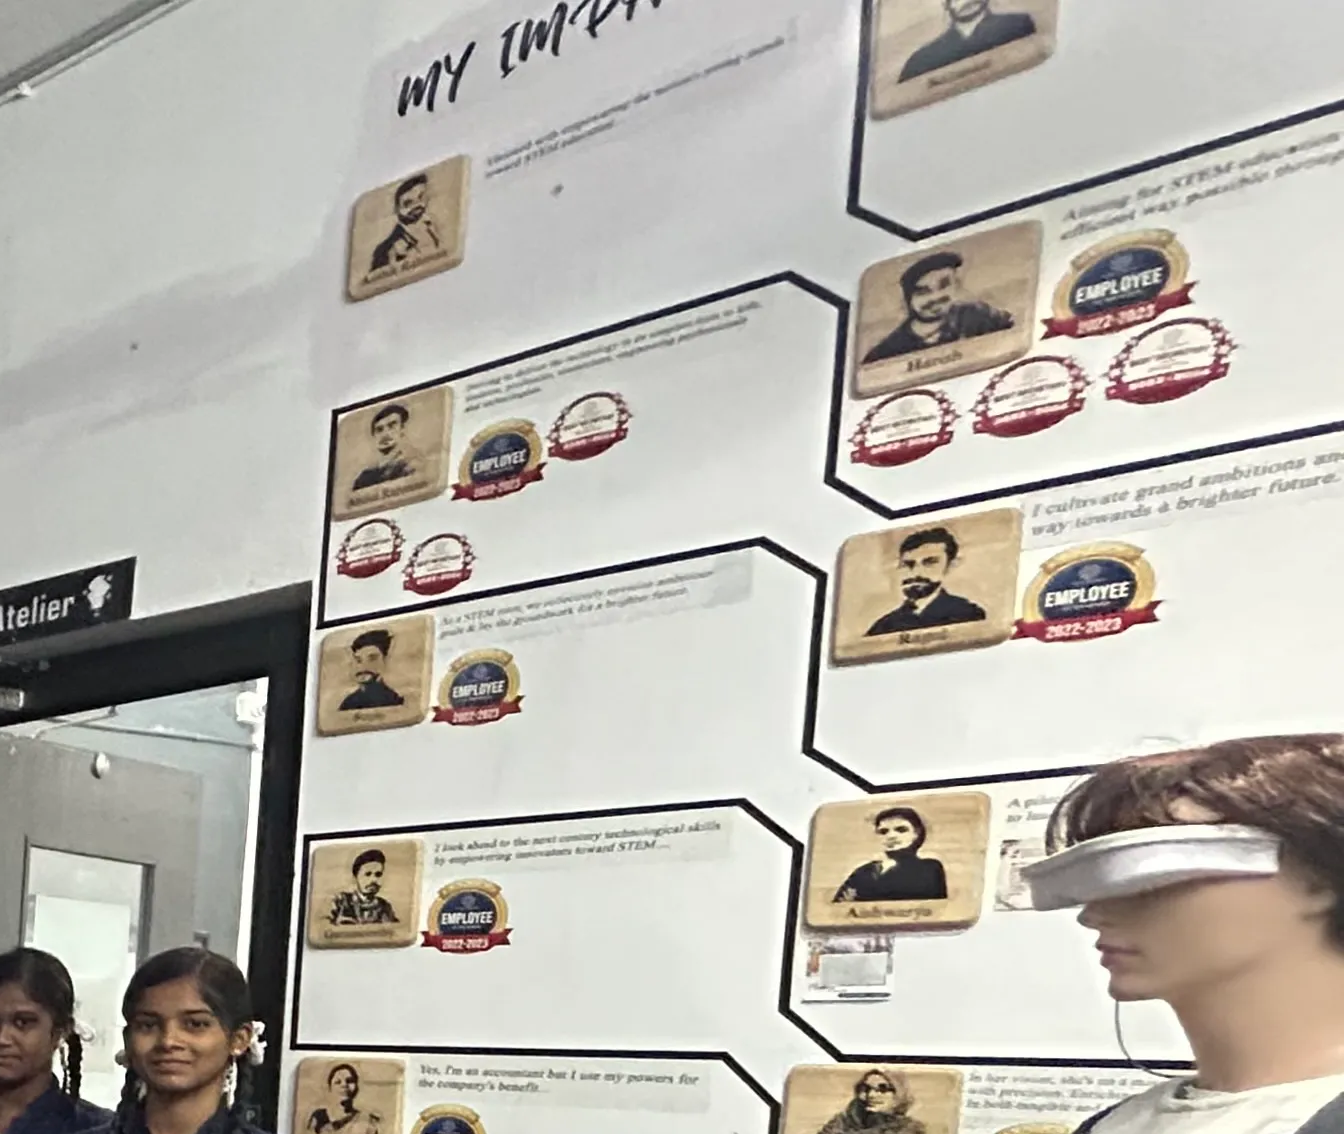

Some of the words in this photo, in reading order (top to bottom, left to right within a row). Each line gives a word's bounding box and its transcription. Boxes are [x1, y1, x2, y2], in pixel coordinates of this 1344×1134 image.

[398, 41, 476, 116] MY
[1075, 265, 1164, 305] EMPLOYEE
[473, 448, 527, 474] EMPLOYEE
[1032, 502, 1042, 519] I
[1045, 488, 1130, 517] cultivate
[1134, 476, 1195, 503] grand
[1199, 456, 1307, 488] ambitions
[1031, 520, 1069, 538] way
[1076, 503, 1153, 530] towards
[1158, 502, 1171, 515] a
[1176, 486, 1262, 513] brighter
[1268, 471, 1342, 496] future.
[1044, 580, 1131, 609] EMPLOYEE
[1045, 617, 1123, 639] 2022-2023
[452, 679, 506, 699] EMPLOYEE
[467, 838, 498, 851] ahead
[513, 836, 531, 847] the
[605, 823, 686, 840] technological
[688, 820, 722, 833] skills
[434, 855, 447, 867] by
[448, 851, 513, 867] empowering
[514, 846, 574, 861] innovators
[575, 842, 616, 856] toward
[440, 910, 494, 926] EMPLOYEE
[418, 1077, 436, 1089] the
[437, 1079, 496, 1094] company's
[445, 1064, 463, 1076] I'm
[482, 1067, 545, 1080] accountant
[547, 1068, 568, 1081] but
[579, 1072, 601, 1082] use
[603, 1072, 625, 1085] my
[627, 1074, 674, 1086] powers
[678, 1073, 701, 1087] for
